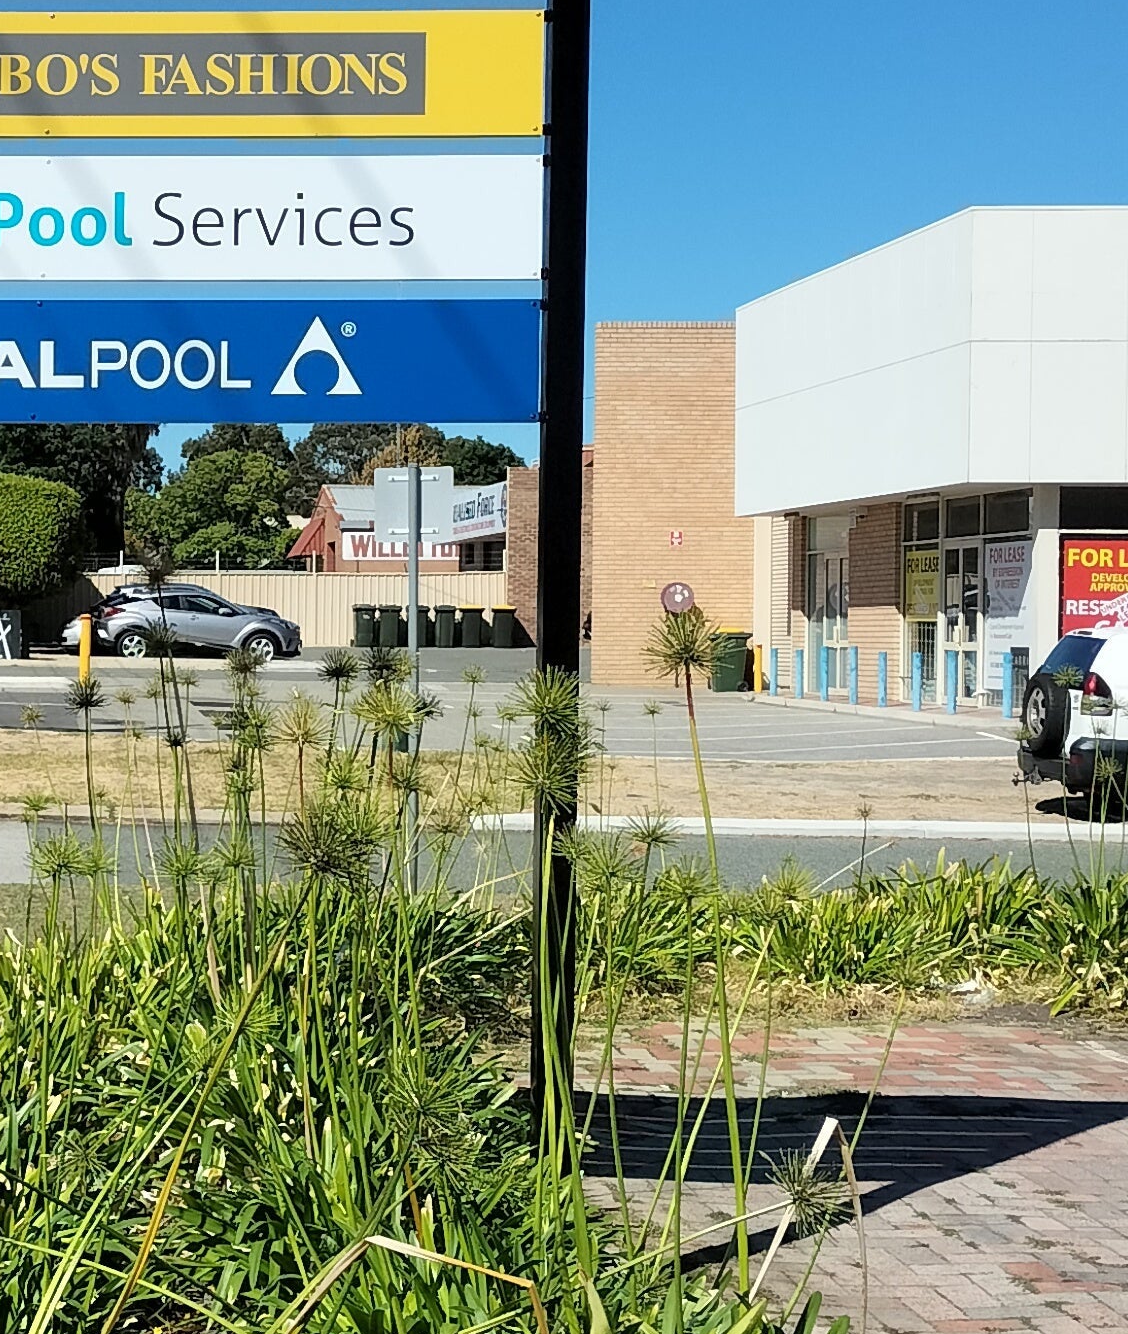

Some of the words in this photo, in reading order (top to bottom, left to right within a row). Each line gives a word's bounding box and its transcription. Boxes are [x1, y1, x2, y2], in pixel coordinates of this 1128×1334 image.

[142, 53, 408, 96] FASHIONS
[152, 192, 415, 247] Services
[907, 557, 920, 574] FOR
[921, 556, 940, 573] LEASE
[989, 548, 1002, 564] FOR
[1004, 546, 1025, 563] LEASE
[1067, 548, 1114, 568] FOR
